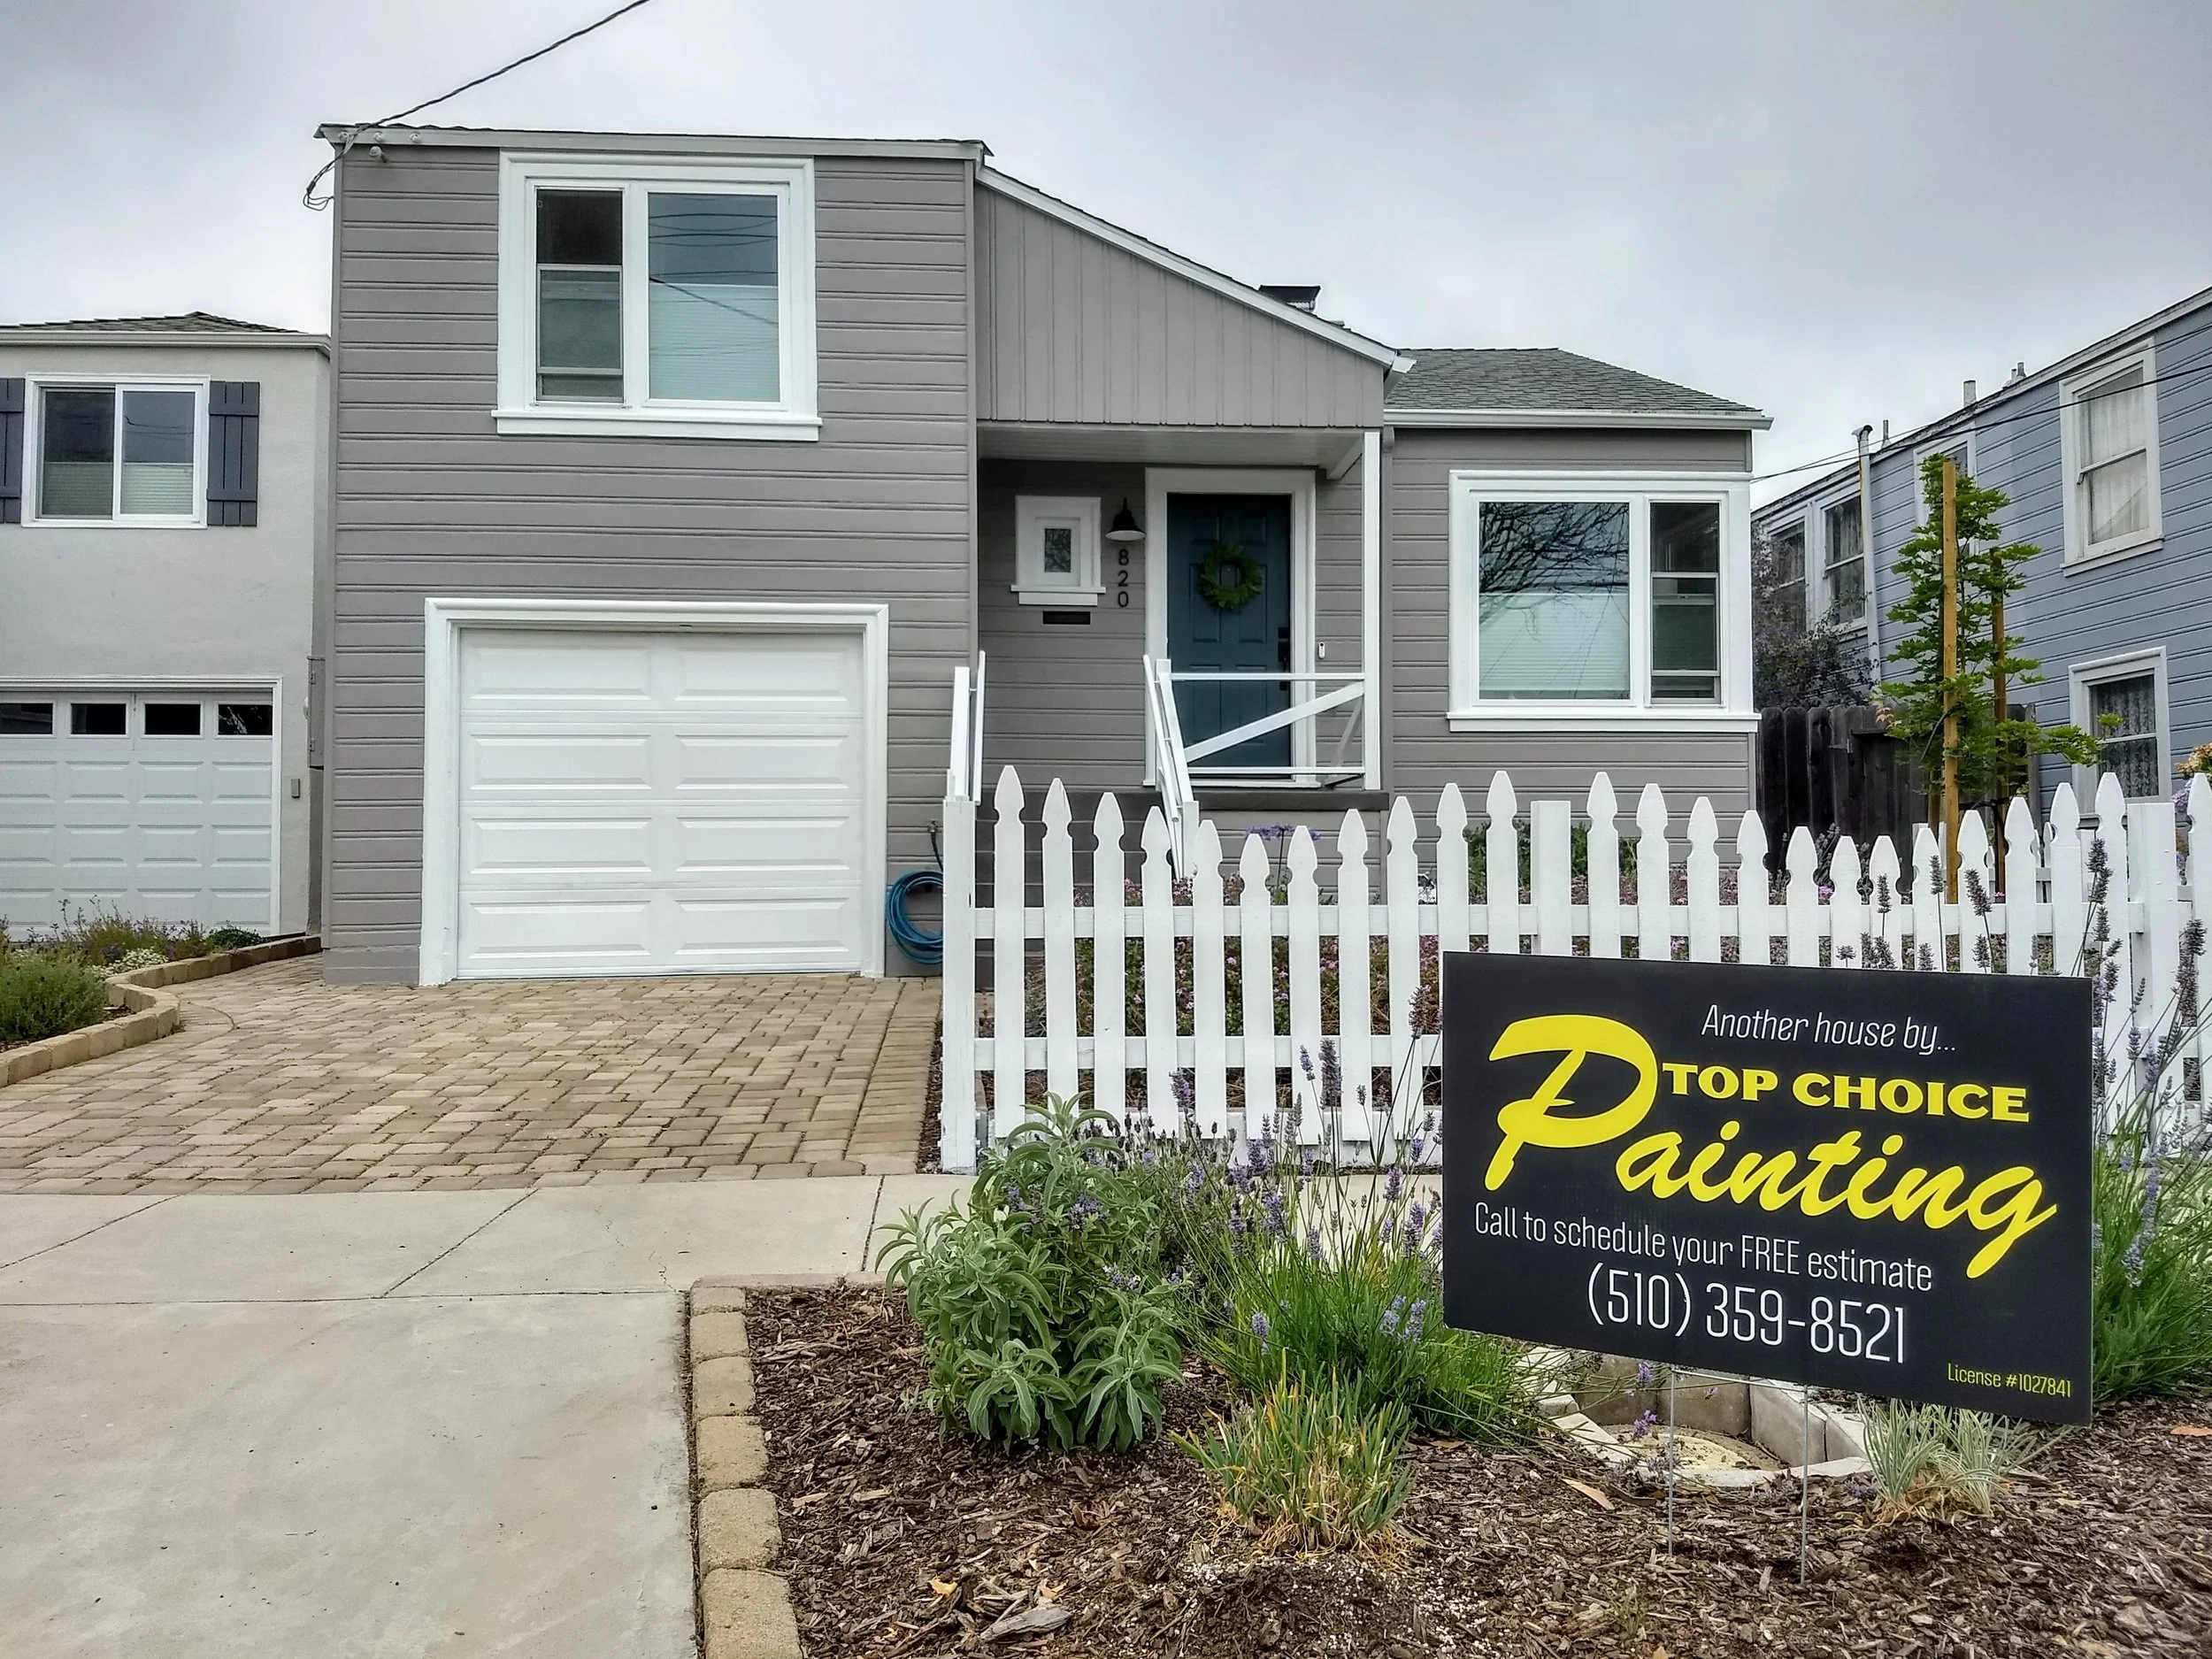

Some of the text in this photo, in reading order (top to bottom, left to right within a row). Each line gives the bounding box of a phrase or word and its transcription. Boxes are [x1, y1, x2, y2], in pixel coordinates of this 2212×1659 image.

[1117, 549, 1130, 609] 820
[1701, 1004, 1957, 1056] Another house by...
[1662, 1062, 2030, 1123] TOP CHOICE
[1484, 1014, 2057, 1279] Painting
[1475, 1202, 1932, 1292] Call to schedule your FREE estimate
[1588, 1262, 1904, 1364] (510) 359-8521
[1947, 1363, 2071, 1398] License #1027841
